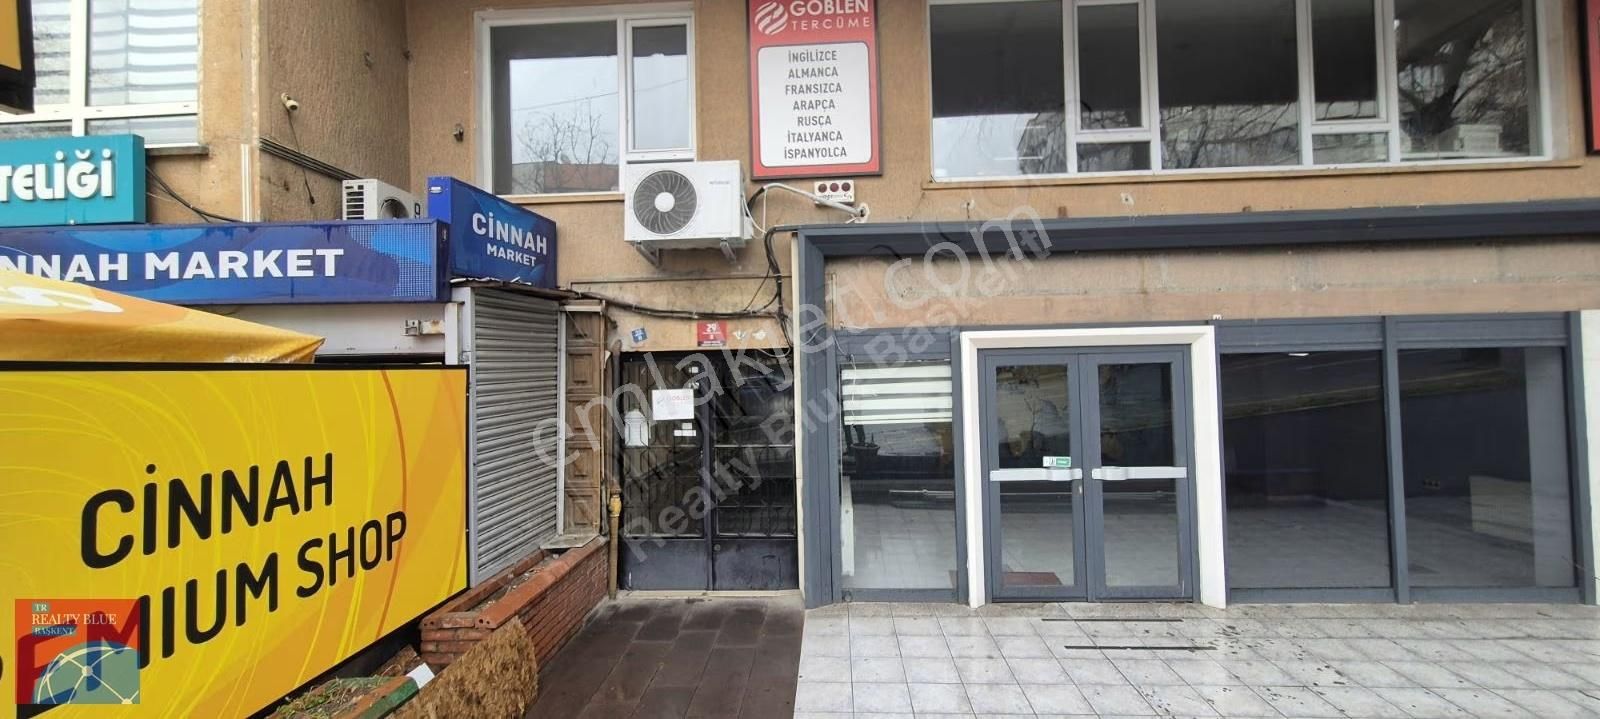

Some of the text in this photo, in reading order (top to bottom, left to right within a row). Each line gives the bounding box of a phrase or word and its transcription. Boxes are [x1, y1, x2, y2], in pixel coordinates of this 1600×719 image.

[790, 0, 869, 16] GOBLEN
[791, 17, 871, 31] TERCÜME
[788, 49, 838, 63] İNGİLİZCE
[788, 66, 839, 79] ALMANCA
[785, 82, 843, 95] FRANSIZCA
[793, 99, 836, 112] ARAPÇA
[797, 115, 832, 128] RUSÇA
[787, 130, 843, 143] İTALYANCA
[784, 146, 847, 159] İSPANYOLCA
[0, 148, 113, 202] TELİĞİ
[472, 211, 548, 256] CİNNAH
[486, 243, 537, 267] MARKET
[144, 248, 344, 280] MARKET
[81, 453, 333, 569] CİNNAH
[296, 511, 407, 599] SHOP
